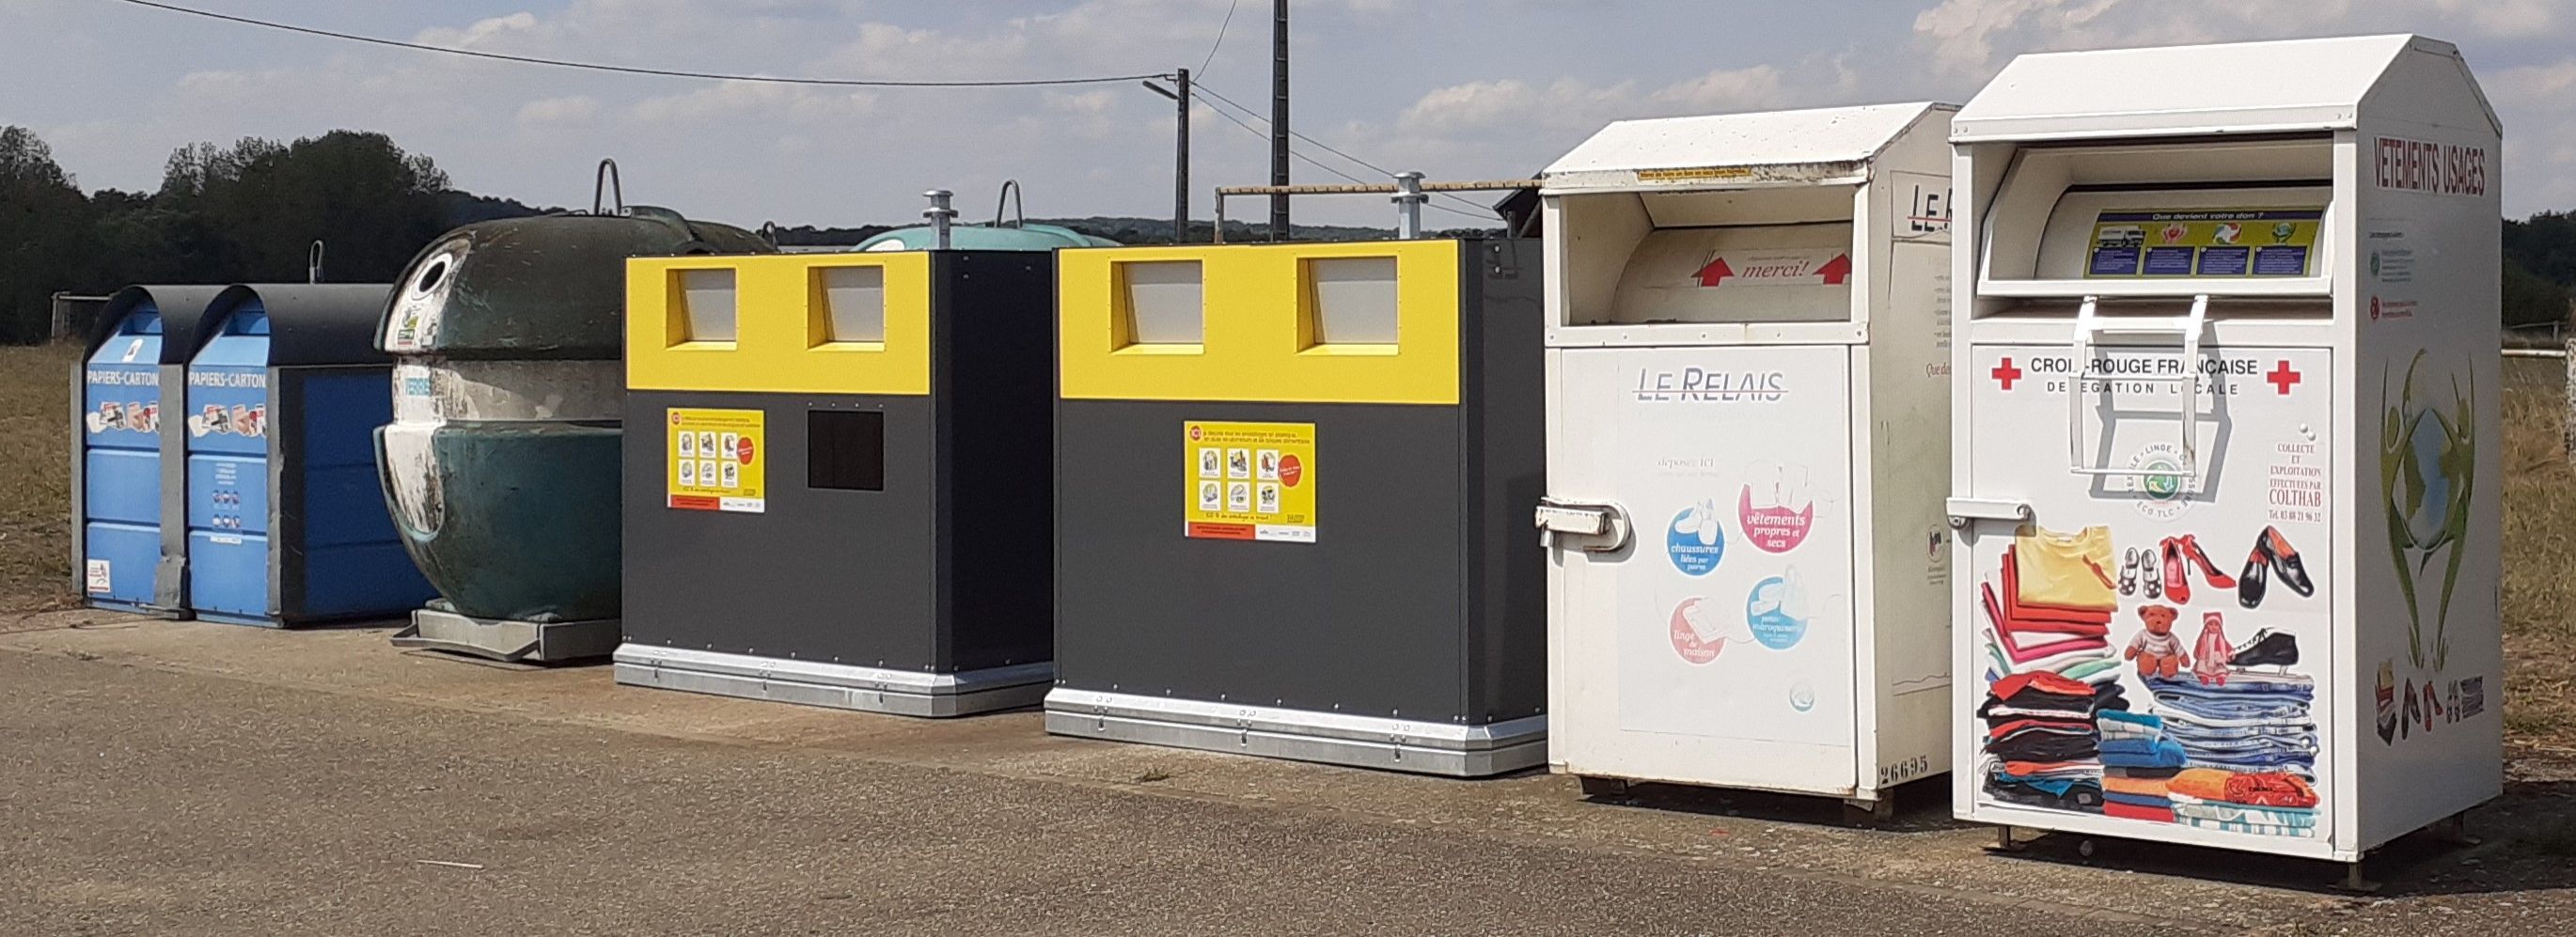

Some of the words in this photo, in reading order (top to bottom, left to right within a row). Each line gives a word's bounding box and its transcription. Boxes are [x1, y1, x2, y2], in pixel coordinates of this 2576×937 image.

[2374, 137, 2440, 193] VETEMENTS
[2443, 145, 2486, 196] USAGES
[1742, 260, 1810, 278] merci!
[2031, 357, 2152, 373] CROI-ROUGE
[87, 370, 159, 386] PAPIERS-CARTON
[189, 371, 266, 388] PAPIERS-CARTON
[1638, 367, 1673, 401] LE
[1681, 367, 1783, 401] RELAIS
[2047, 382, 2155, 394] DEEGATION
[2170, 383, 2238, 396] LCALE
[2277, 444, 2315, 454] COLLECTE
[2291, 455, 2301, 464] ET
[2270, 465, 2321, 476] EXPLOITATION
[2270, 489, 2321, 507] COLTHAB
[1747, 513, 1806, 526] vêtements
[1753, 528, 1791, 538] propres
[1671, 542, 1719, 554] chaussures
[1881, 755, 1928, 785] 26695
